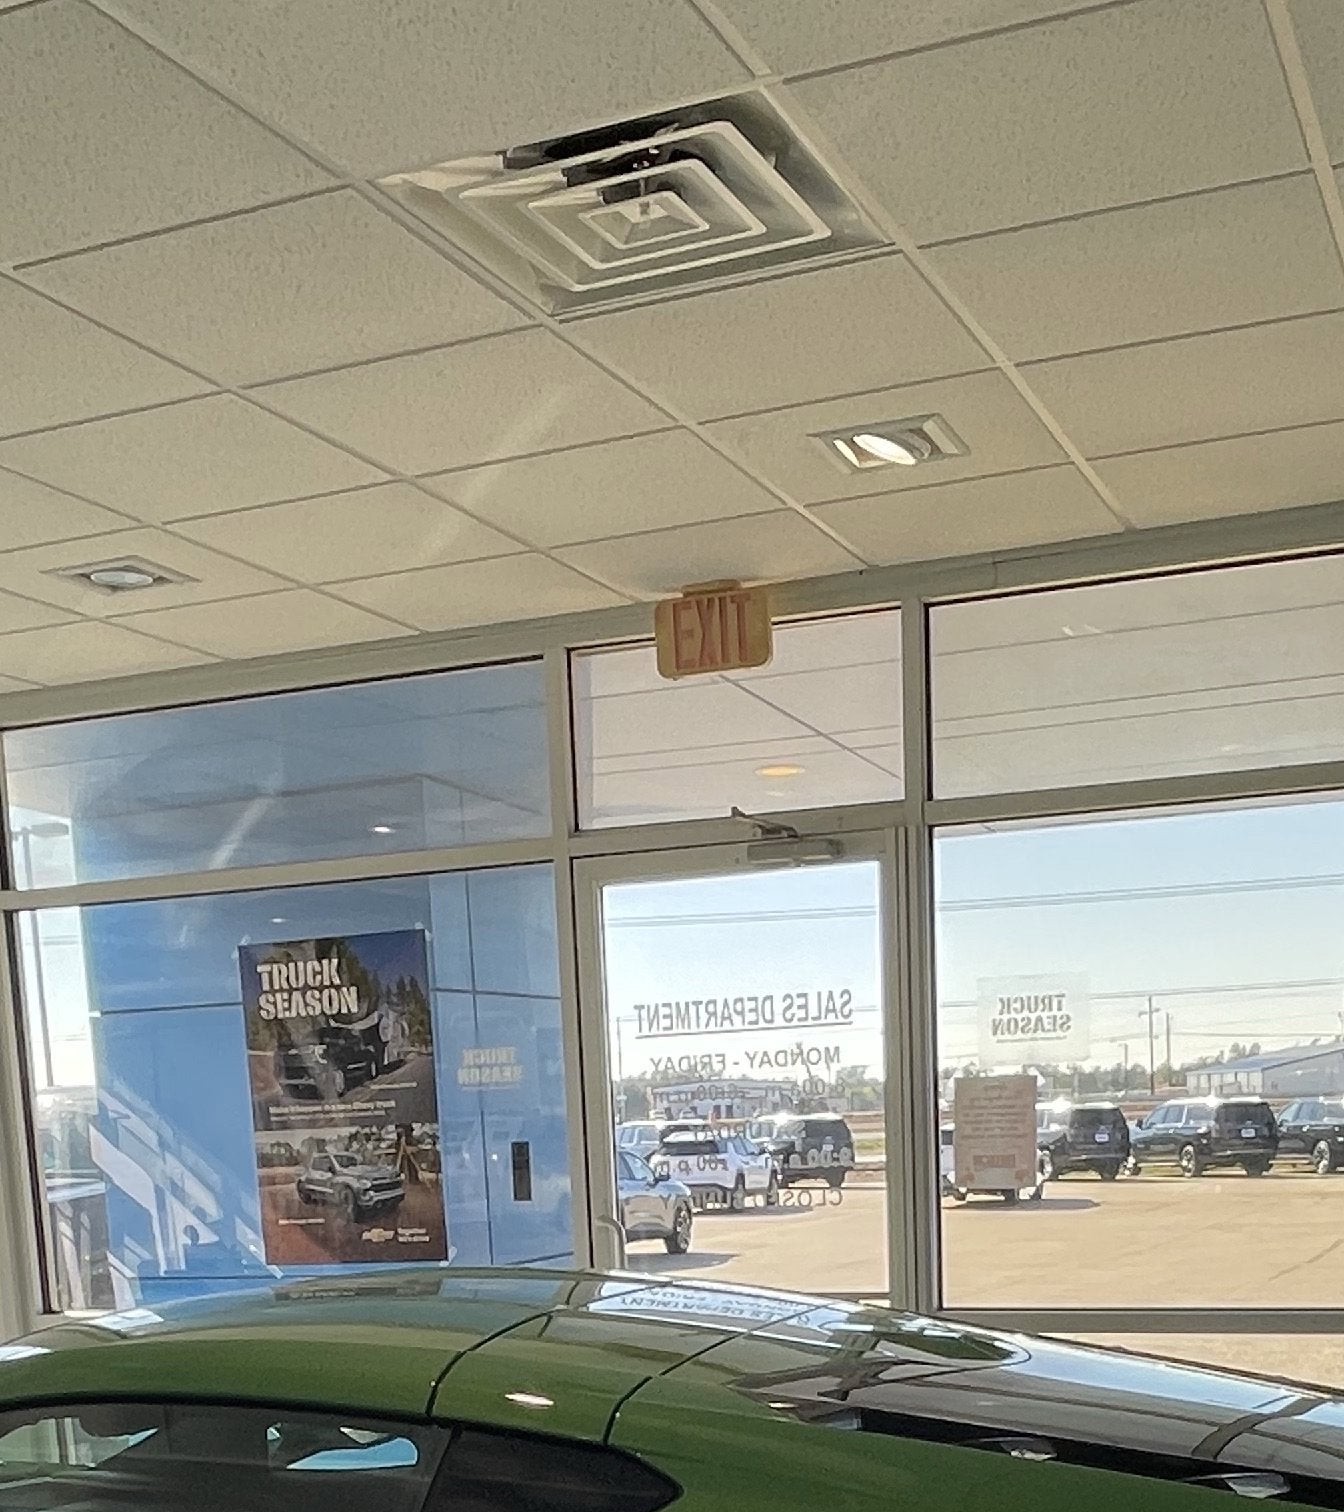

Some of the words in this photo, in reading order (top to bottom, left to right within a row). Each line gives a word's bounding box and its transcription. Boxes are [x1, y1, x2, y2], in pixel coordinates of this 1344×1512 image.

[672, 591, 752, 671] EXIT
[256, 957, 341, 991] TRUCK
[258, 986, 358, 1021] SEASON
